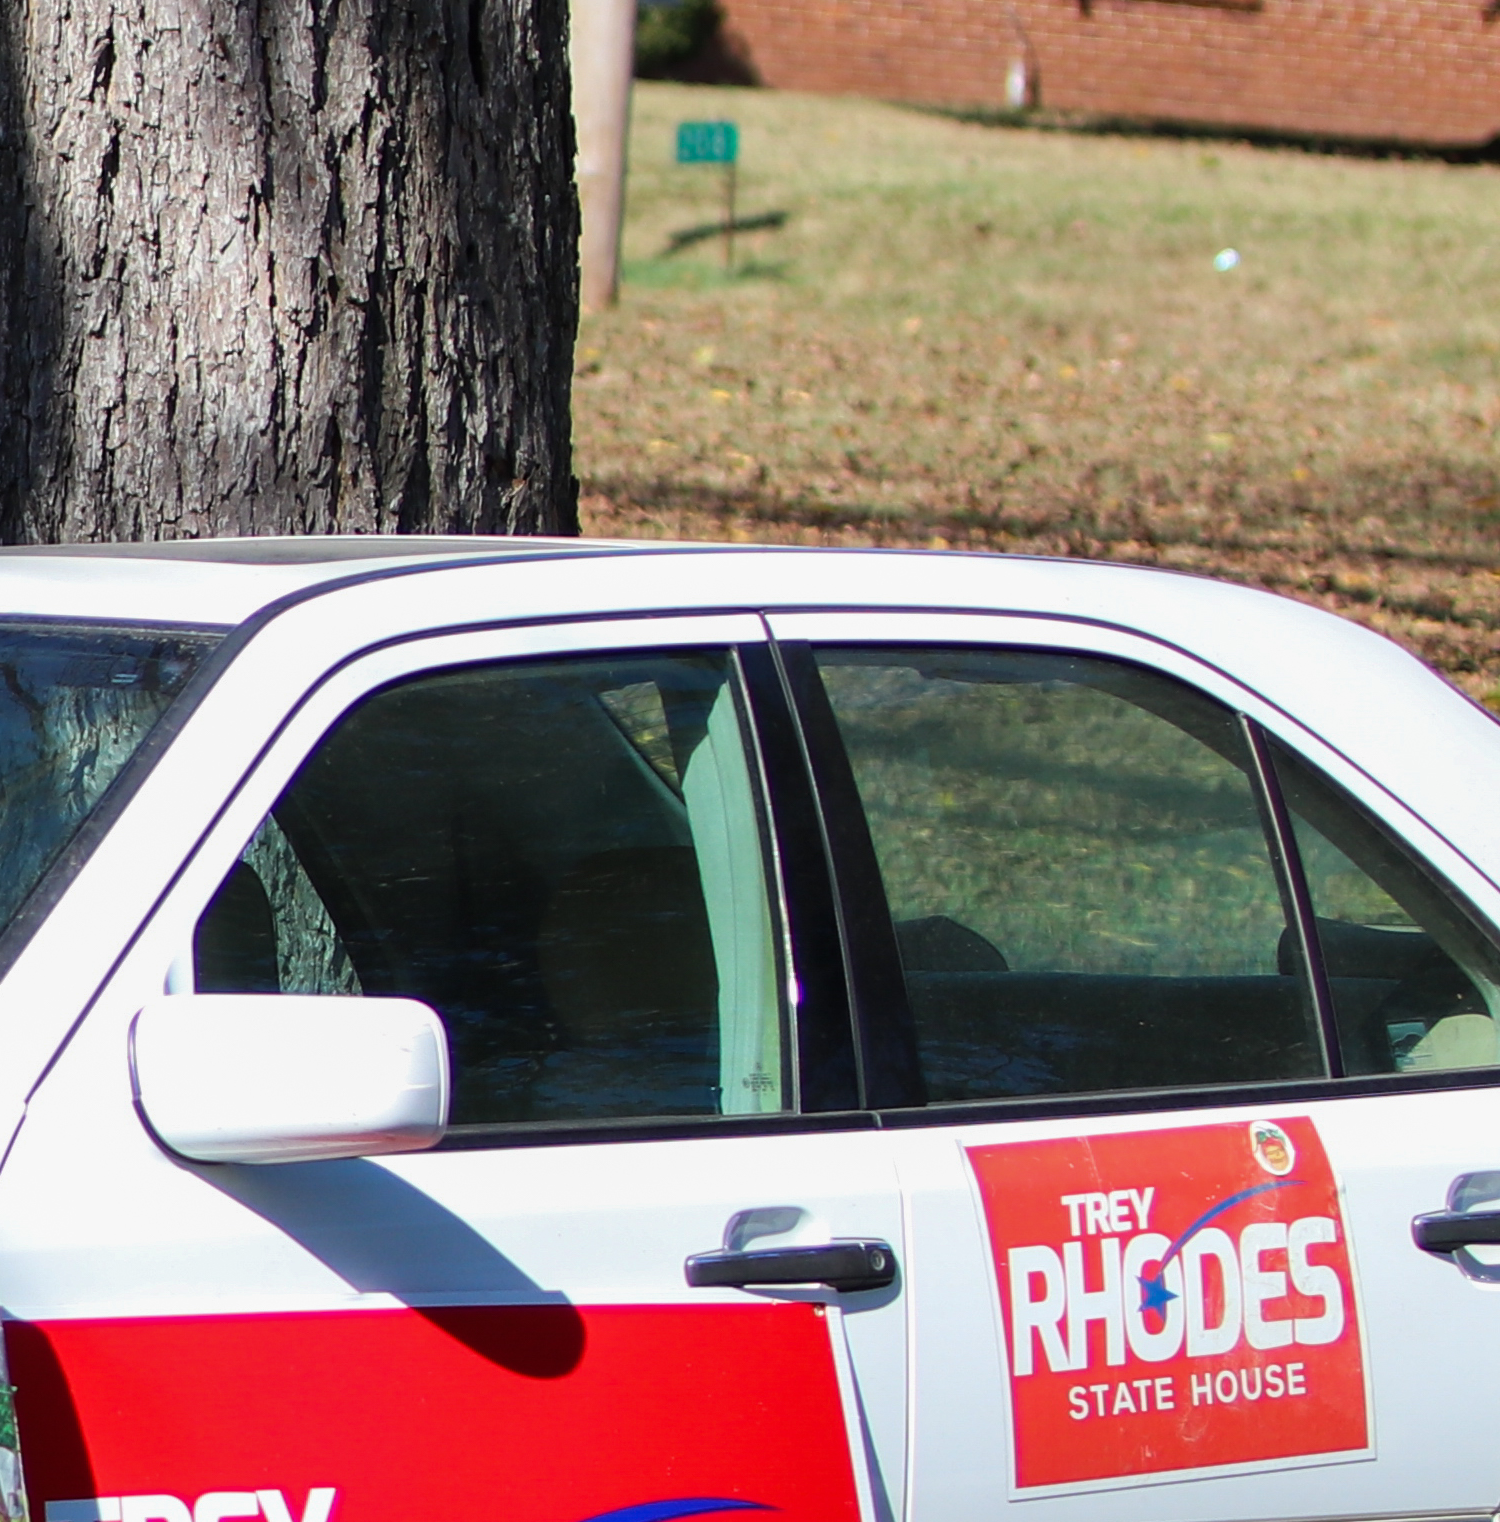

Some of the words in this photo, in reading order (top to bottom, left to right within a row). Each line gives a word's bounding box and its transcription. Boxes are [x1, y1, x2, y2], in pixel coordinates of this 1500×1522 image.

[1061, 1186, 1155, 1237] TREY
[1007, 1216, 1345, 1377] RHODES
[1068, 1376, 1176, 1421] STATE
[1191, 1362, 1307, 1407] HOUSE
